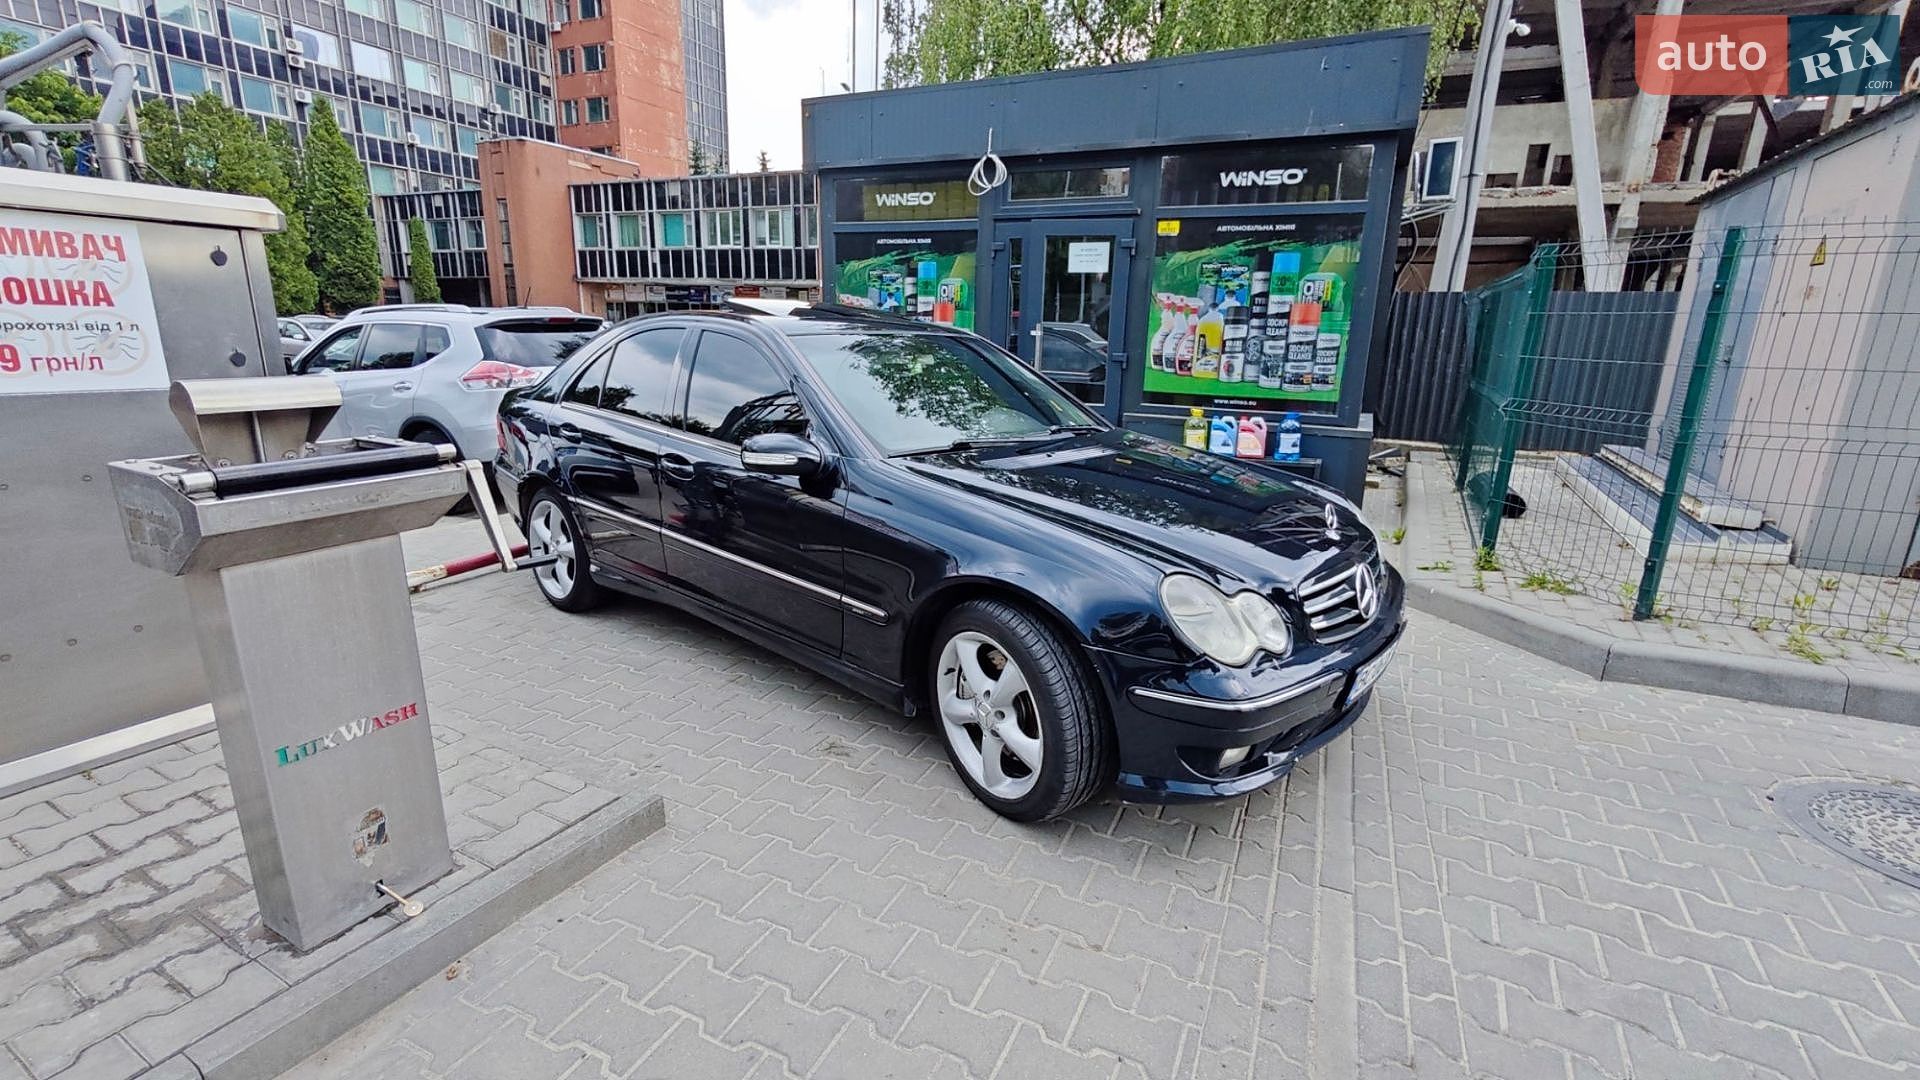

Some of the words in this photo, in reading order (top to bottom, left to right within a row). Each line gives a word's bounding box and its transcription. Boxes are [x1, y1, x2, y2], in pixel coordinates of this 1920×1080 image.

[1216, 224, 1274, 232] АВТОМОБІЛЬНА
[0, 276, 115, 307] ОШКА
[0, 320, 79, 333] рохотязі
[84, 320, 112, 333] від
[116, 321, 123, 331] 1
[130, 323, 140, 332] л
[30, 352, 104, 377] грн/л
